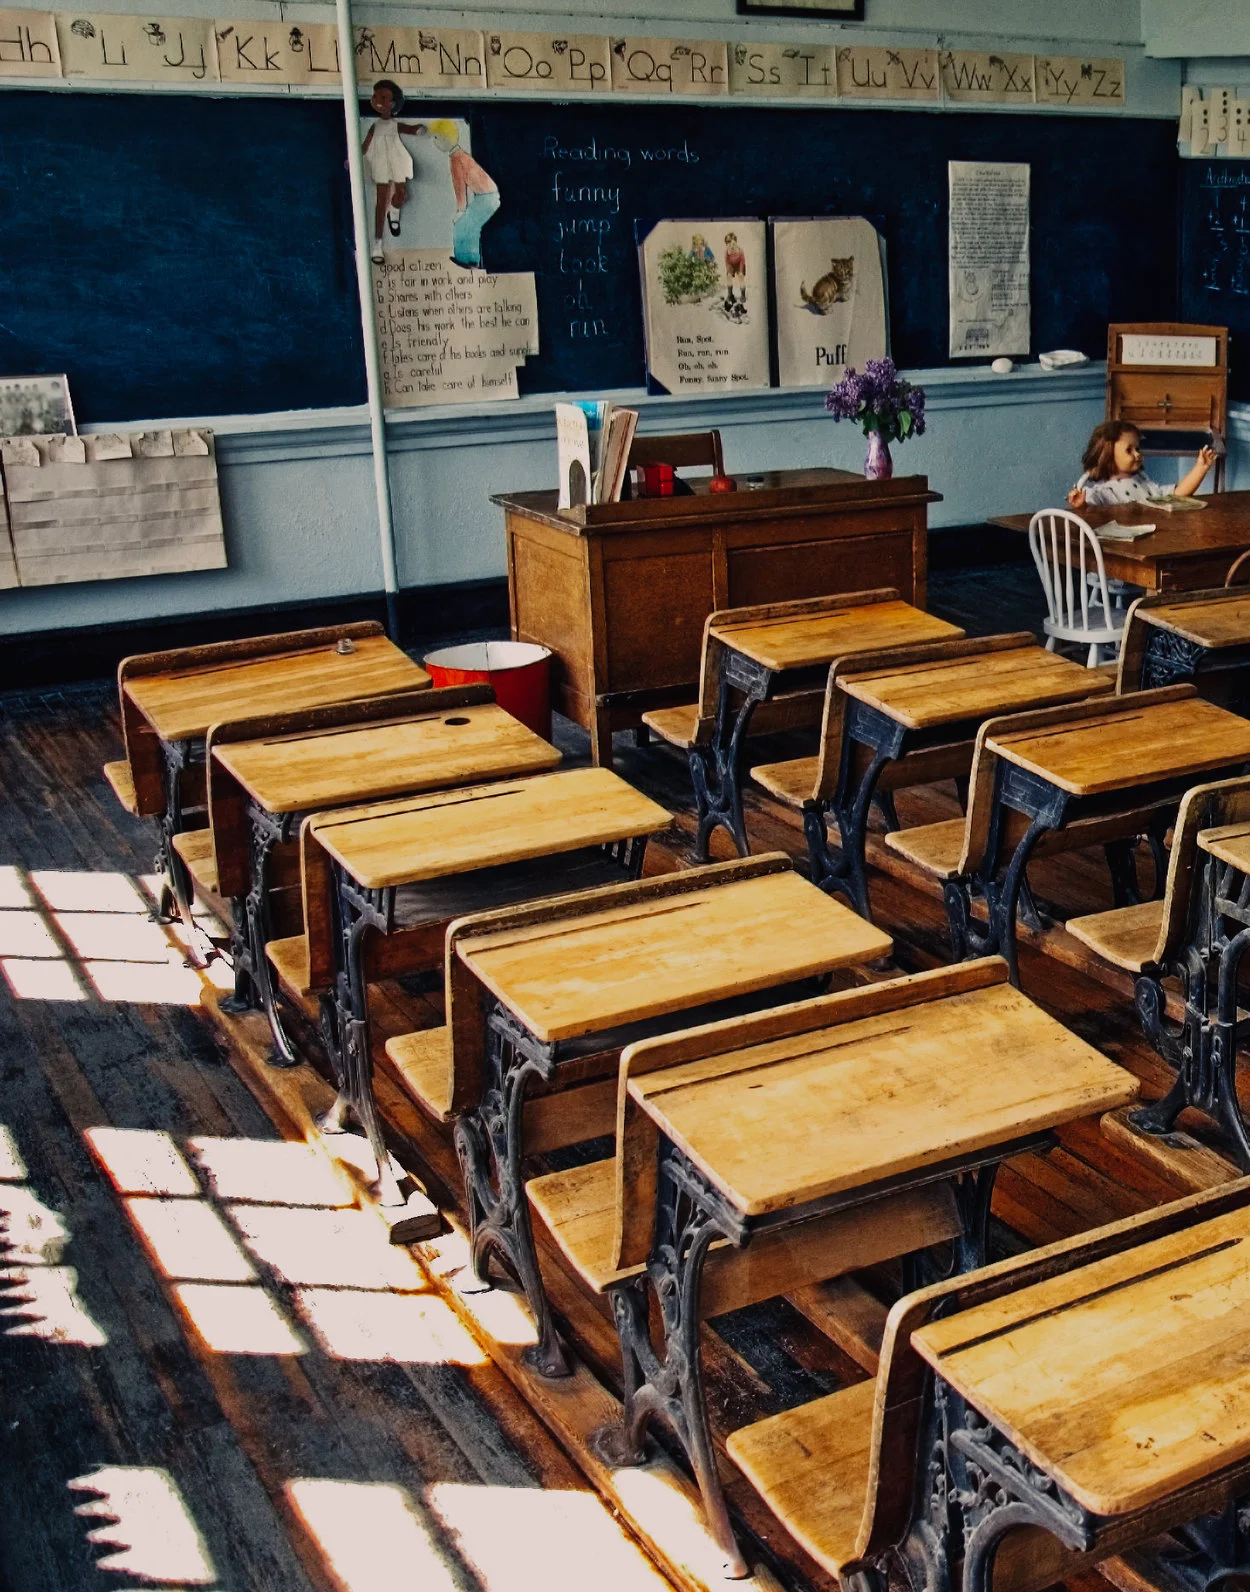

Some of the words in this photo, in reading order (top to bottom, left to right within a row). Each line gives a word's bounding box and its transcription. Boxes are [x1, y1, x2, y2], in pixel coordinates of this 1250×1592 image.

[544, 135, 631, 171] Reading
[641, 140, 700, 163] words
[552, 171, 620, 214] funny
[380, 257, 406, 278] good
[409, 259, 443, 272] citizen
[431, 271, 453, 286] work
[457, 270, 475, 285] and
[478, 275, 498, 288] play
[388, 288, 419, 303] Shares
[424, 289, 443, 303] with
[445, 286, 473, 302] others
[388, 304, 420, 318] Listens
[422, 303, 445, 317] when
[476, 305, 491, 315] are
[494, 299, 523, 314] talking
[388, 319, 413, 336] Does
[417, 317, 431, 332] his
[434, 319, 456, 332] work
[461, 315, 475, 330] the
[479, 315, 498, 329] best
[501, 313, 513, 328] he
[515, 318, 530, 328] can
[390, 349, 414, 364] Takes
[417, 353, 438, 362] care
[450, 345, 462, 361] his
[464, 344, 487, 359] books
[490, 342, 506, 357] and
[407, 331, 450, 355] friendly
[815, 345, 848, 367] Puff
[410, 362, 444, 378] careful
[394, 379, 414, 394] Can
[418, 377, 437, 392] take
[442, 380, 463, 391] care
[481, 372, 513, 389] himself
